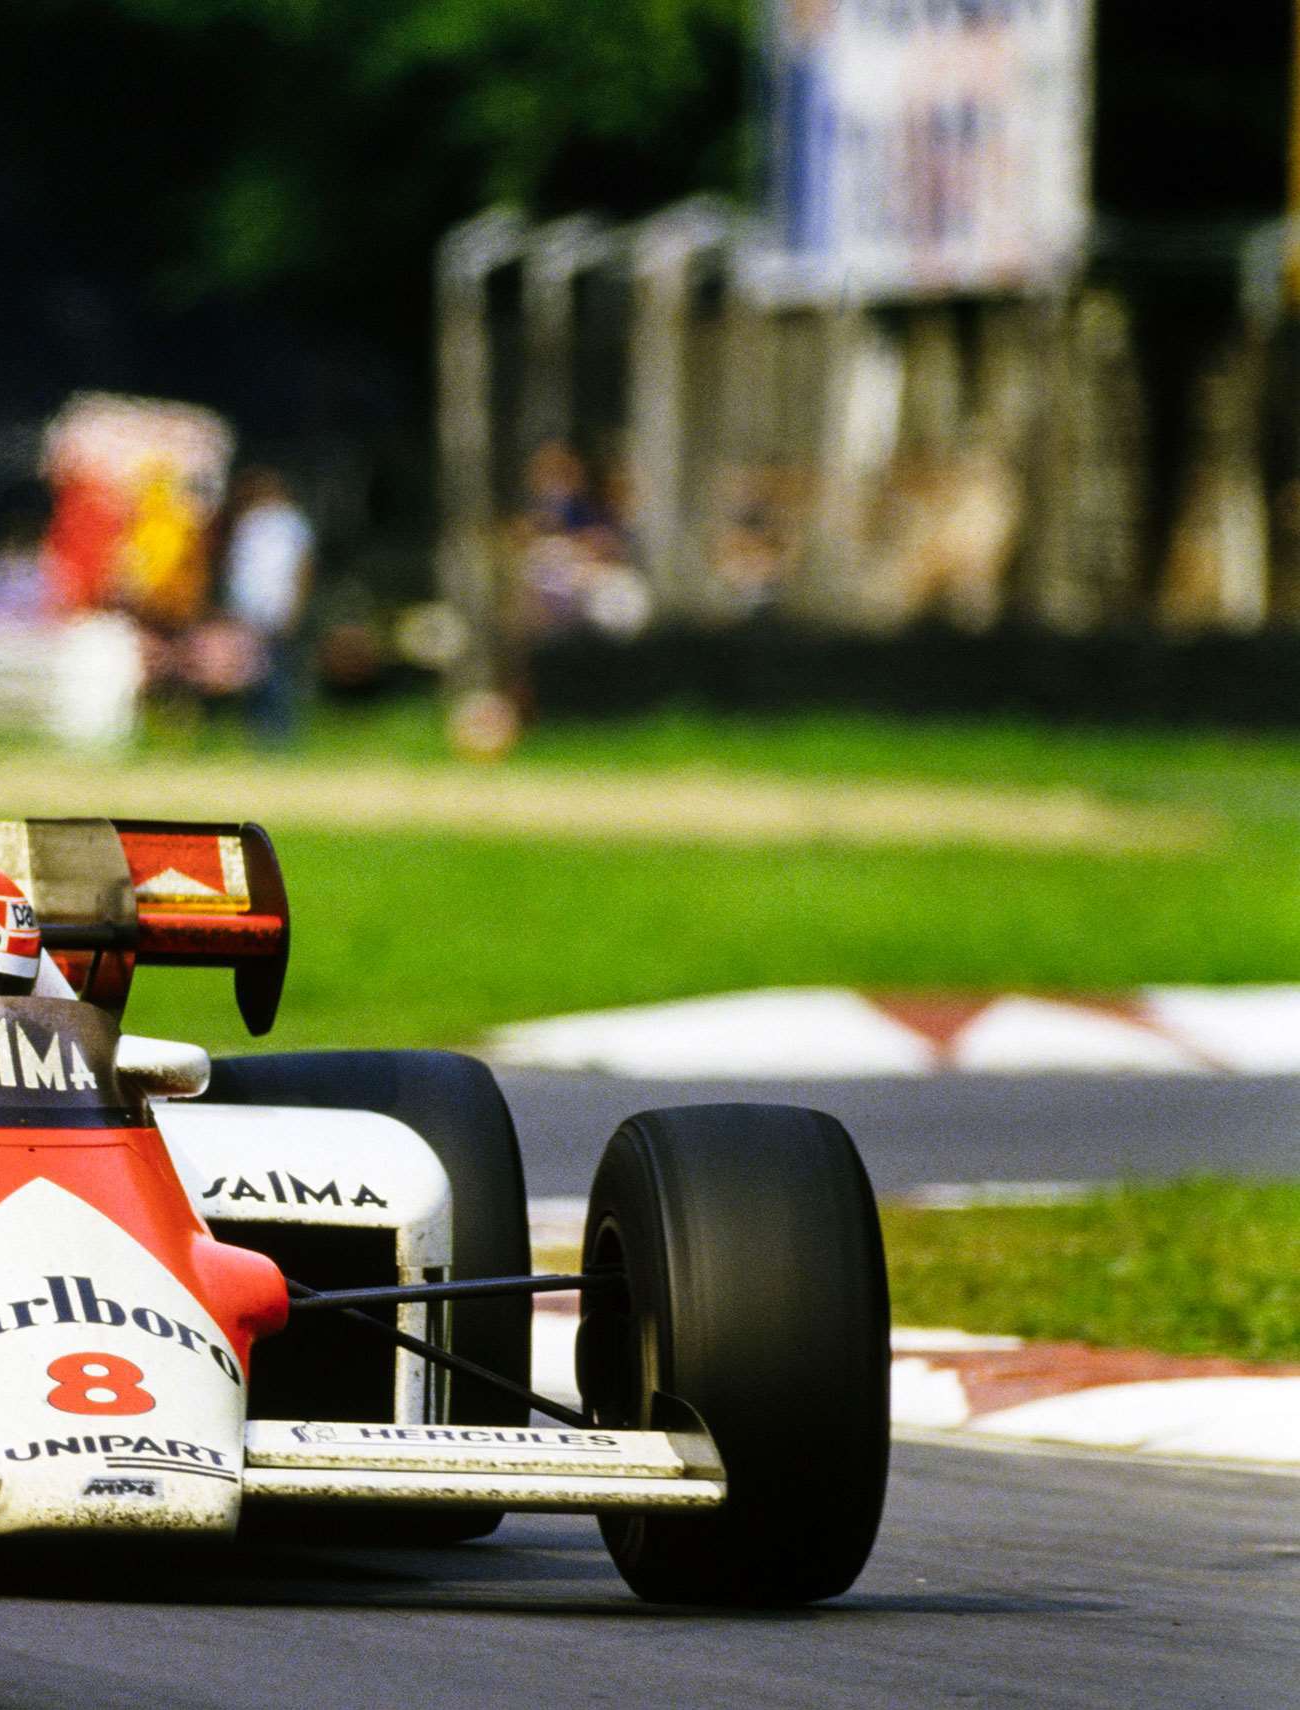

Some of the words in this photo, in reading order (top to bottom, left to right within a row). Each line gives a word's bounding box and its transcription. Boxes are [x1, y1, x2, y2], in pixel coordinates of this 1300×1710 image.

[202, 1170, 388, 1208] SAIMA
[47, 1351, 156, 1416] 8
[5, 1435, 227, 1467] UNIPART
[360, 1427, 618, 1447] HERCULES
